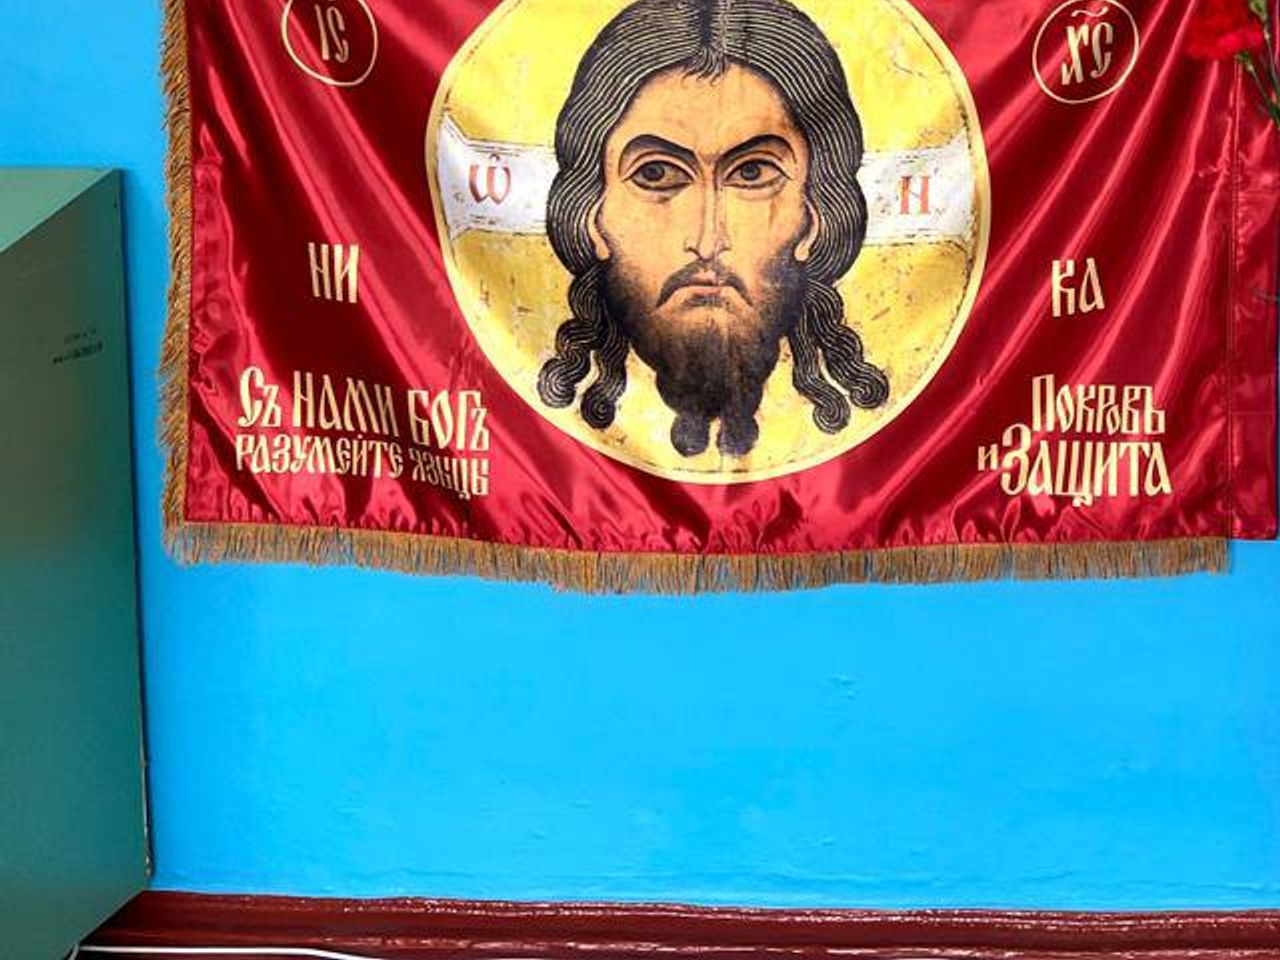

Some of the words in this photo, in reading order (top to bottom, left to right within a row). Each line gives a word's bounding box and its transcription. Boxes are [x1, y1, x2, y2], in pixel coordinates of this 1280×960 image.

[308, 242, 360, 304] НИ
[1051, 257, 1106, 318] КА
[291, 370, 400, 438] НАМИ
